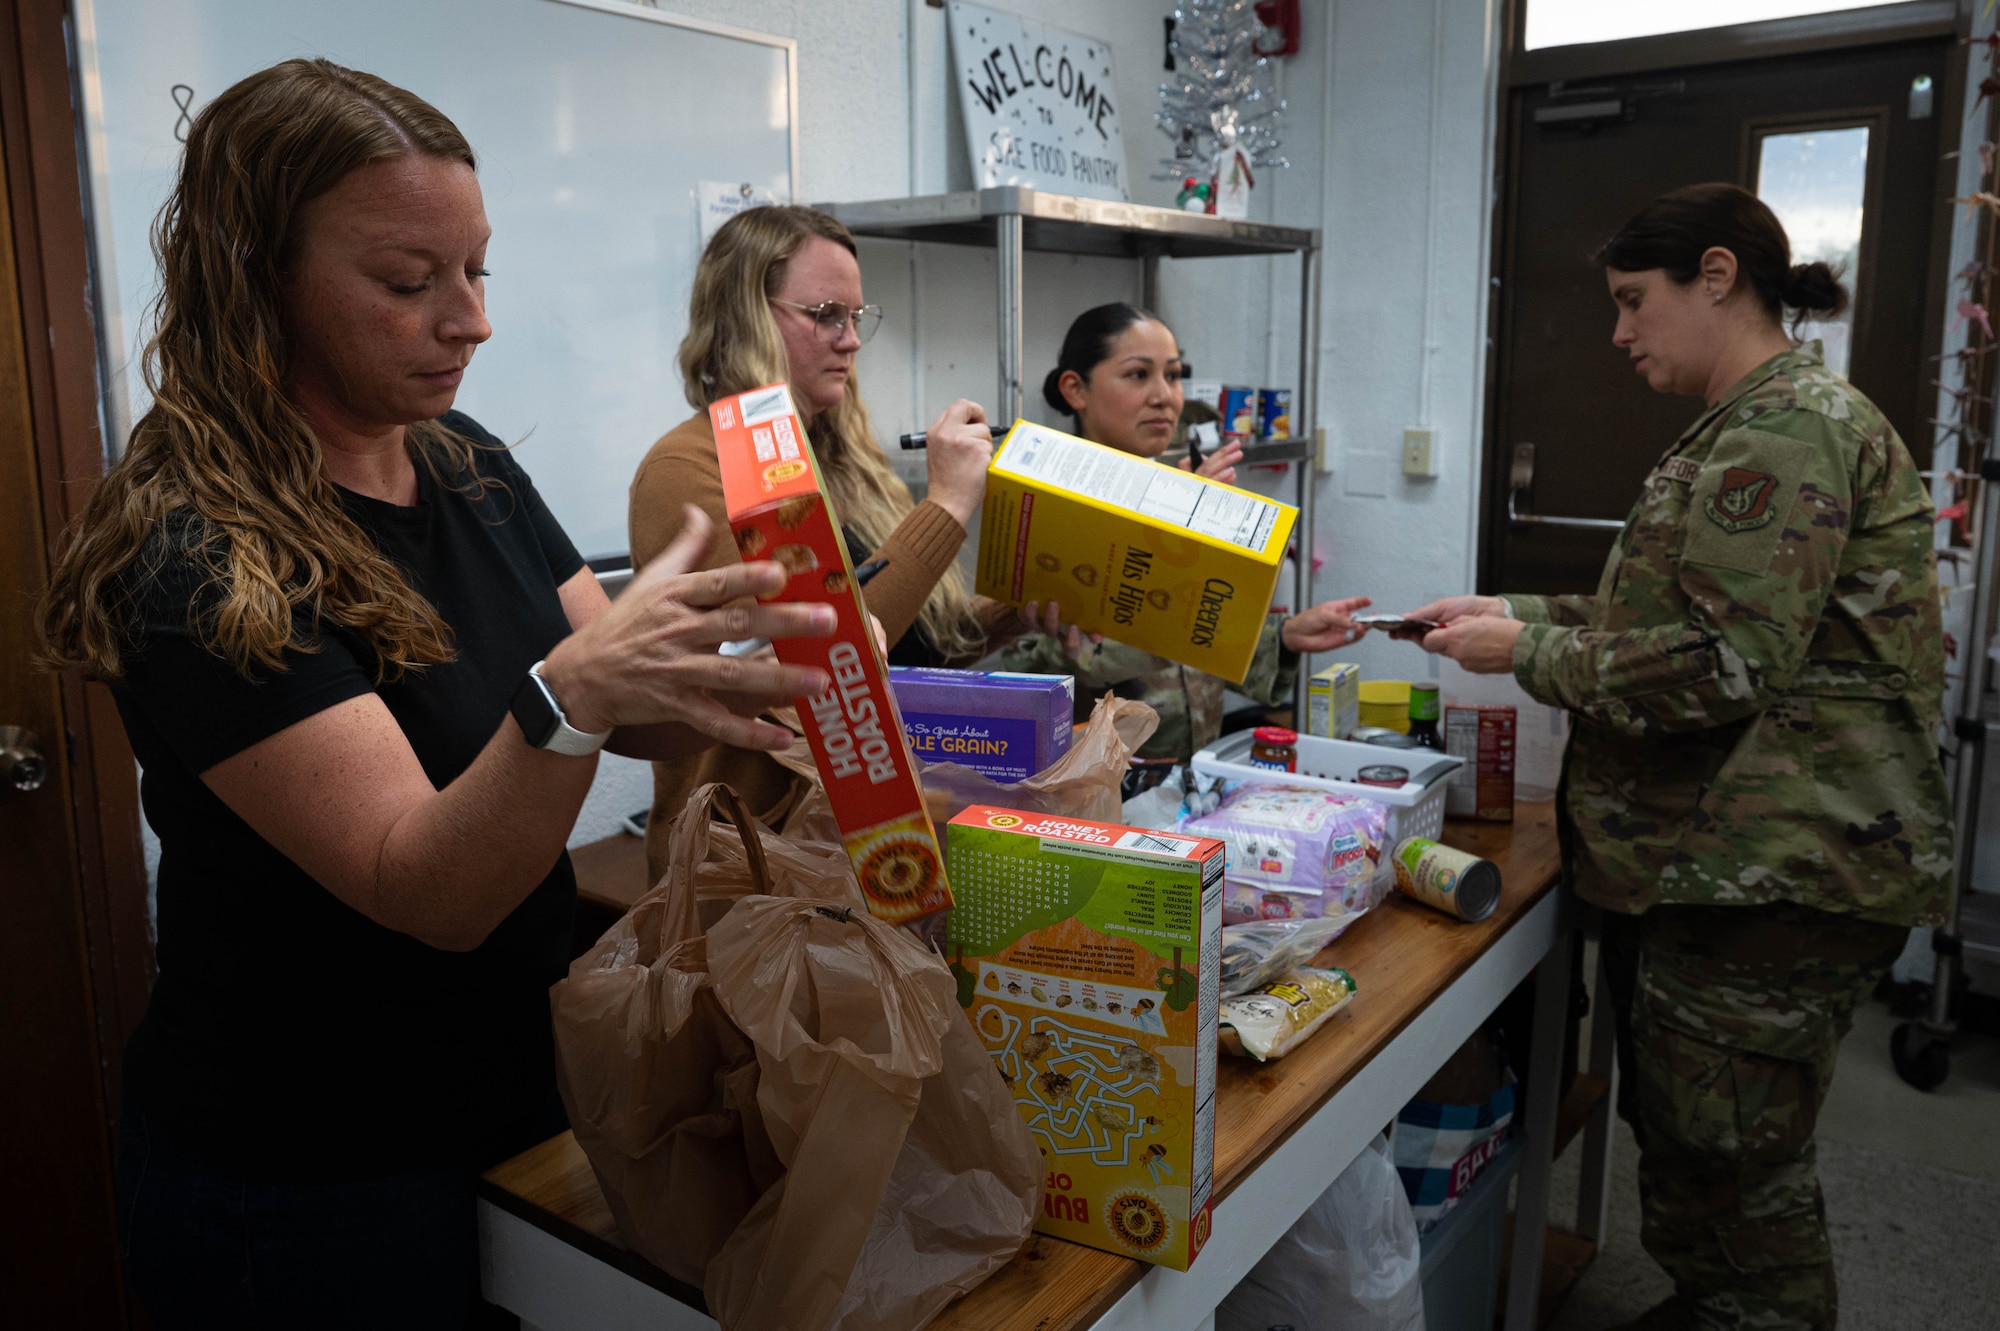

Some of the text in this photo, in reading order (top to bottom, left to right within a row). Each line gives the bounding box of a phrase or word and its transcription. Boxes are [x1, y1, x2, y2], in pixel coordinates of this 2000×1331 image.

[969, 43, 1114, 140] WELCOME
[1038, 106, 1053, 124] TO
[1030, 142, 1067, 177] FOOD
[1071, 150, 1119, 190] PANTRY
[1113, 545, 1153, 626] Mis Hijos
[1191, 577, 1234, 648] Cheerios
[828, 641, 898, 786] ROASTED
[808, 688, 862, 780] HONE
[914, 723, 930, 733] So
[932, 726, 958, 739] Great
[960, 725, 990, 737] About
[907, 734, 1008, 756] OLE GRAIN?
[1040, 820, 1109, 835] HONEY
[1022, 824, 1110, 843] ROASTED
[1057, 844, 1071, 852] puzzle
[1080, 848, 1106, 857] information
[1127, 884, 1155, 892] TOGETHER
[1162, 889, 1192, 897] GOODNESS
[1130, 898, 1155, 906] SPARKLE
[1167, 896, 1192, 904] FROSTED
[1124, 910, 1154, 919] PERFECTED
[1104, 922, 1125, 931] words?
[1128, 918, 1154, 926] MORNING
[1153, 930, 1166, 938] find
[1045, 948, 1074, 956] ingredients
[1110, 946, 1134, 954] returning
[1008, 957, 1024, 965] Honey
[1035, 953, 1055, 961] through
[1042, 961, 1064, 969] delicious
[1048, 1172, 1072, 1191] OF
[1120, 1198, 1146, 1210] OATS
[1115, 1211, 1142, 1245] BUNCHES
[1144, 1221, 1161, 1245] HONEY
